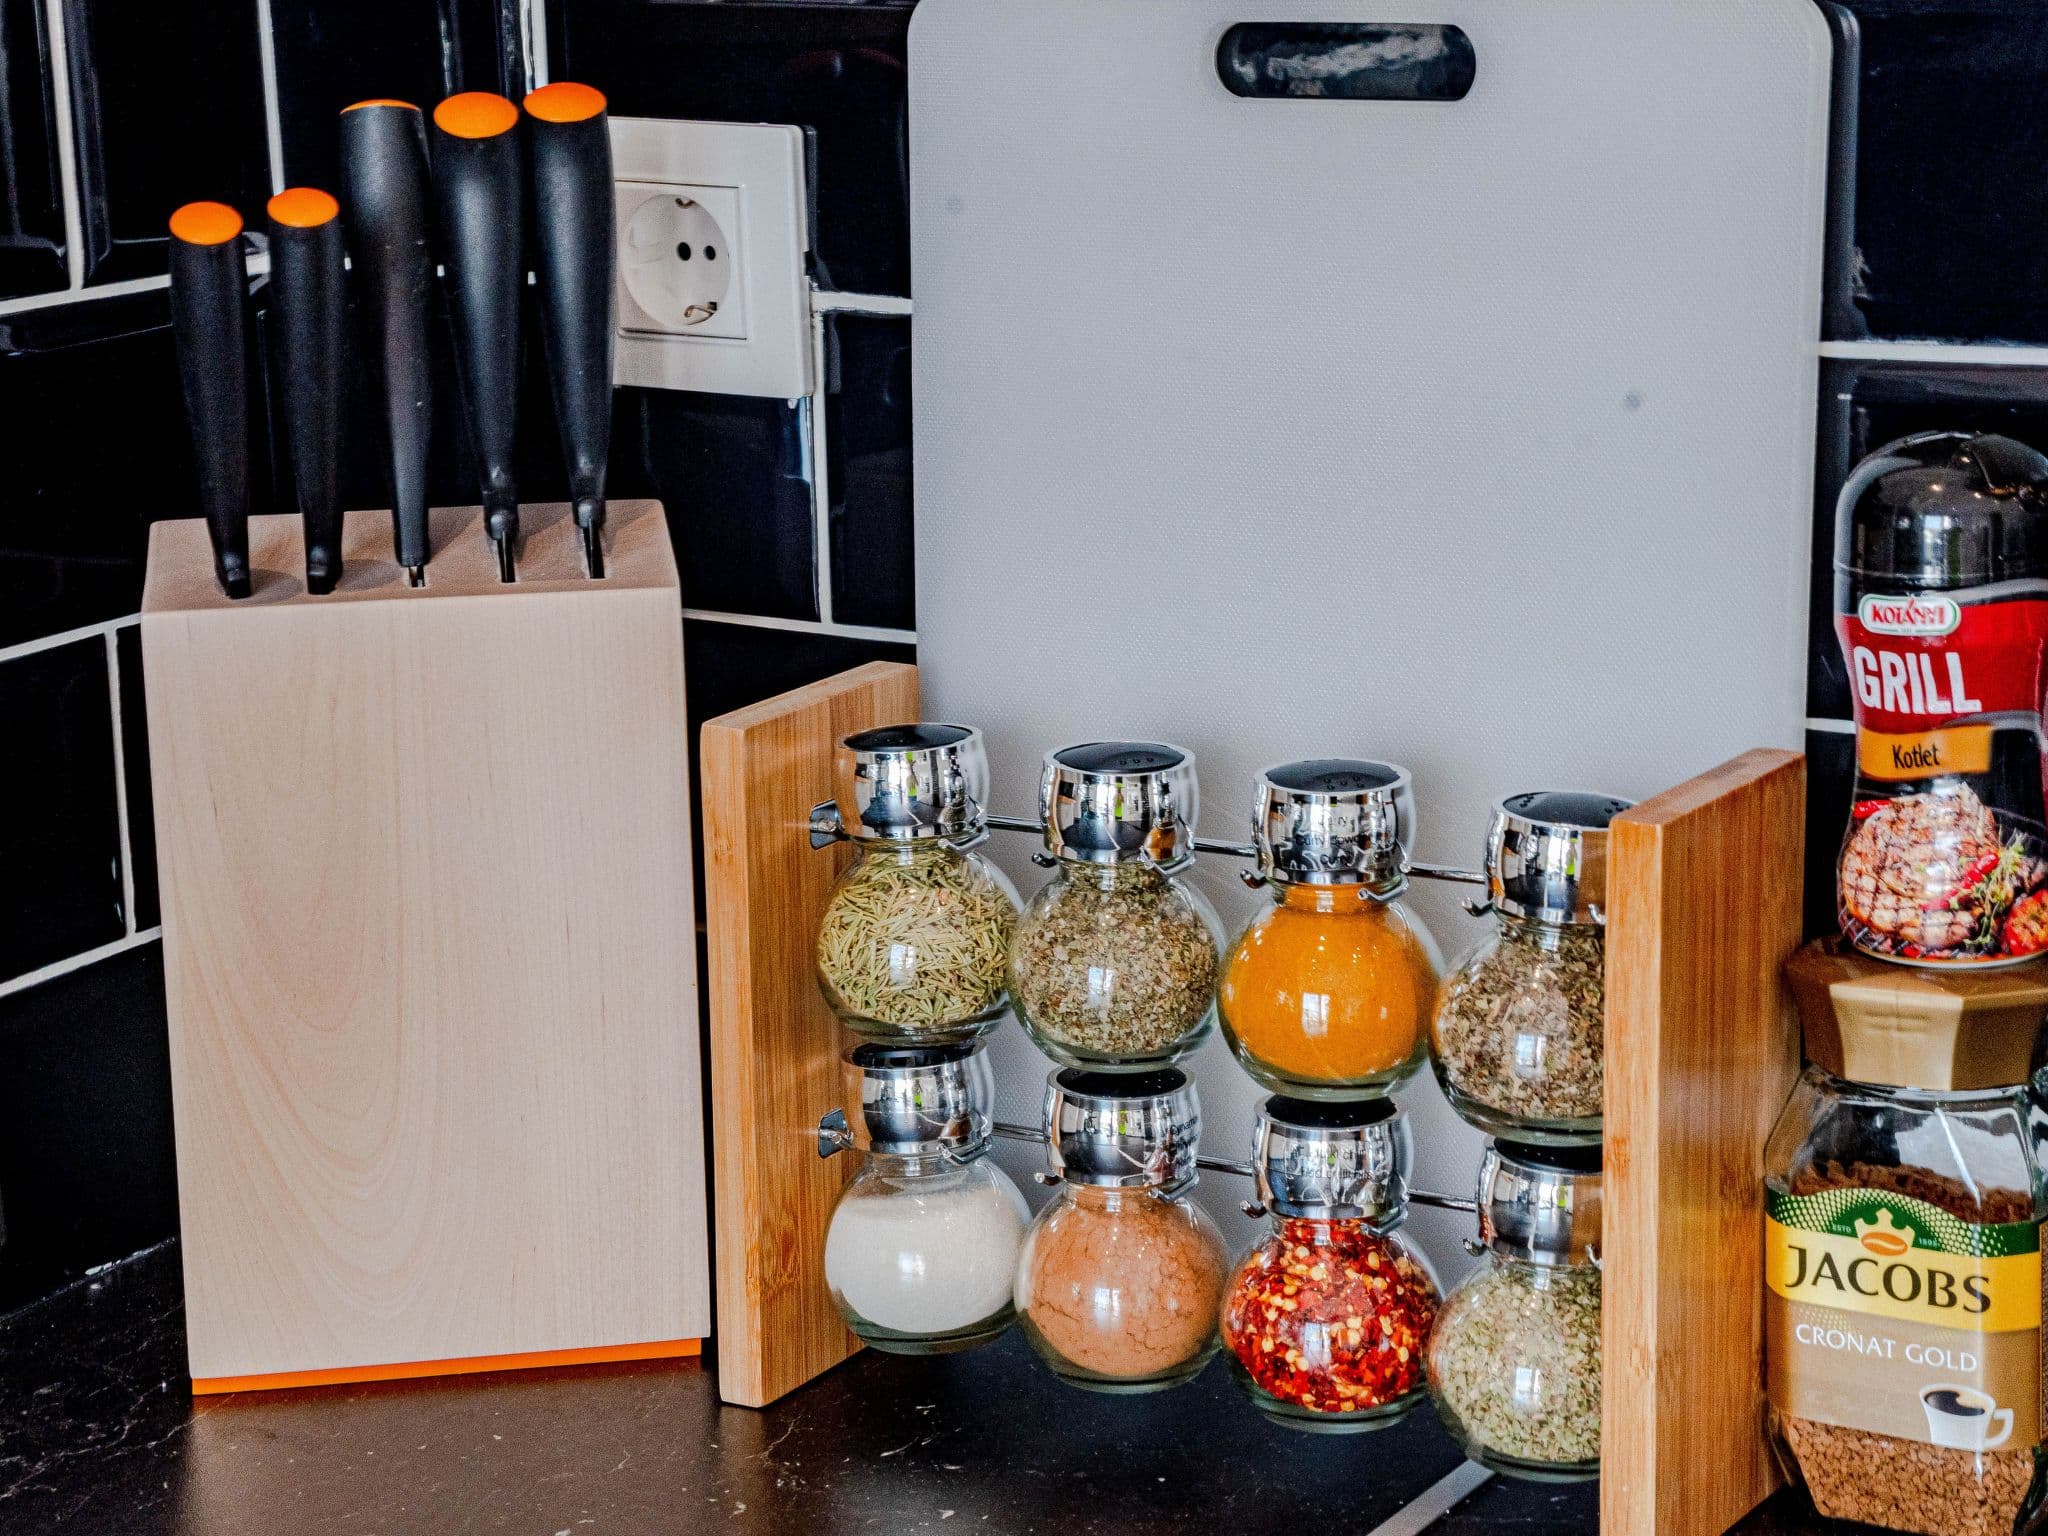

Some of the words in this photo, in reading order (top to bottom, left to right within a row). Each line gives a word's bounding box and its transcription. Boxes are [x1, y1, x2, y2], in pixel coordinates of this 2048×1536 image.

[1853, 646, 1982, 714] GRILL
[1891, 743, 1941, 769] Kotlet
[1785, 1244, 1992, 1314] JACOBS
[1795, 1324, 1897, 1360] CRONAT
[1904, 1343, 1978, 1373] GOLD
